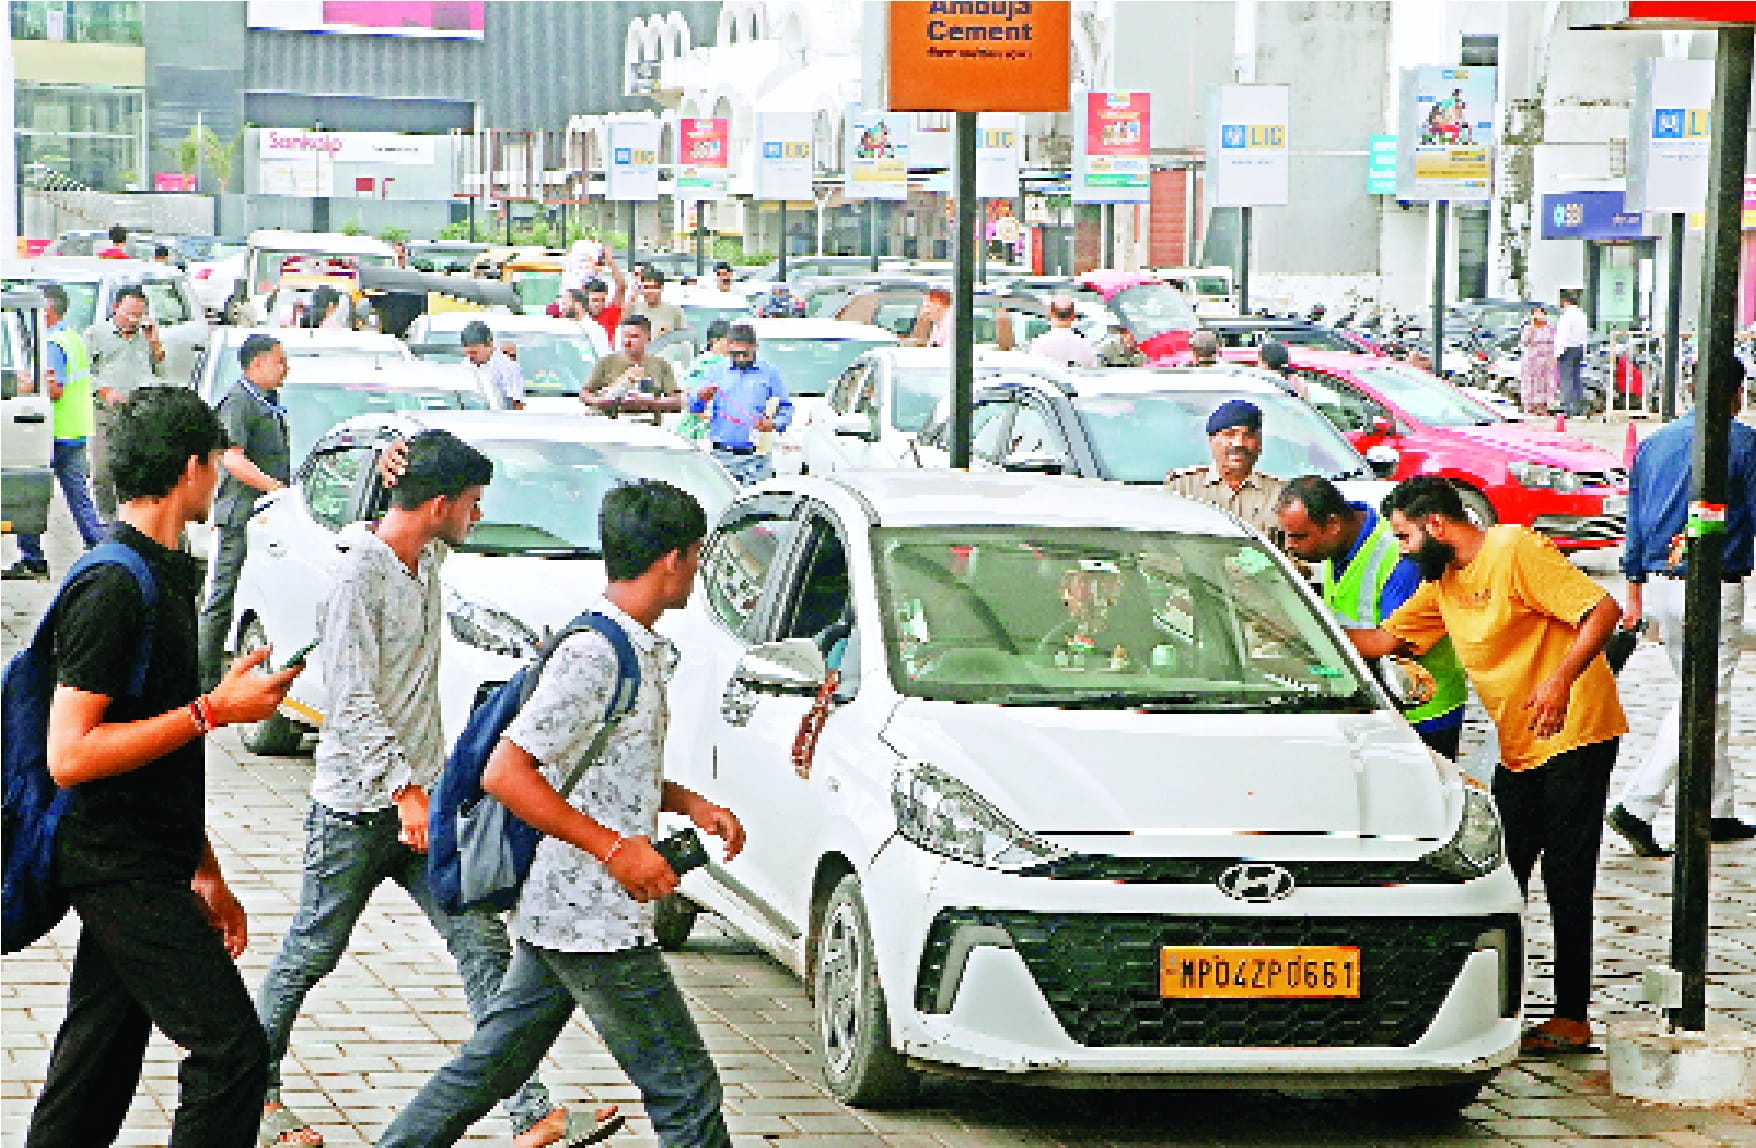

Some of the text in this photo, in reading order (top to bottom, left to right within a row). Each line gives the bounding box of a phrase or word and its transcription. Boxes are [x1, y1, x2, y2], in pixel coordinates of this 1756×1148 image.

[927, 20, 1032, 40] Cement
[269, 131, 343, 158] Sankalp
[1251, 127, 1282, 146] LIC
